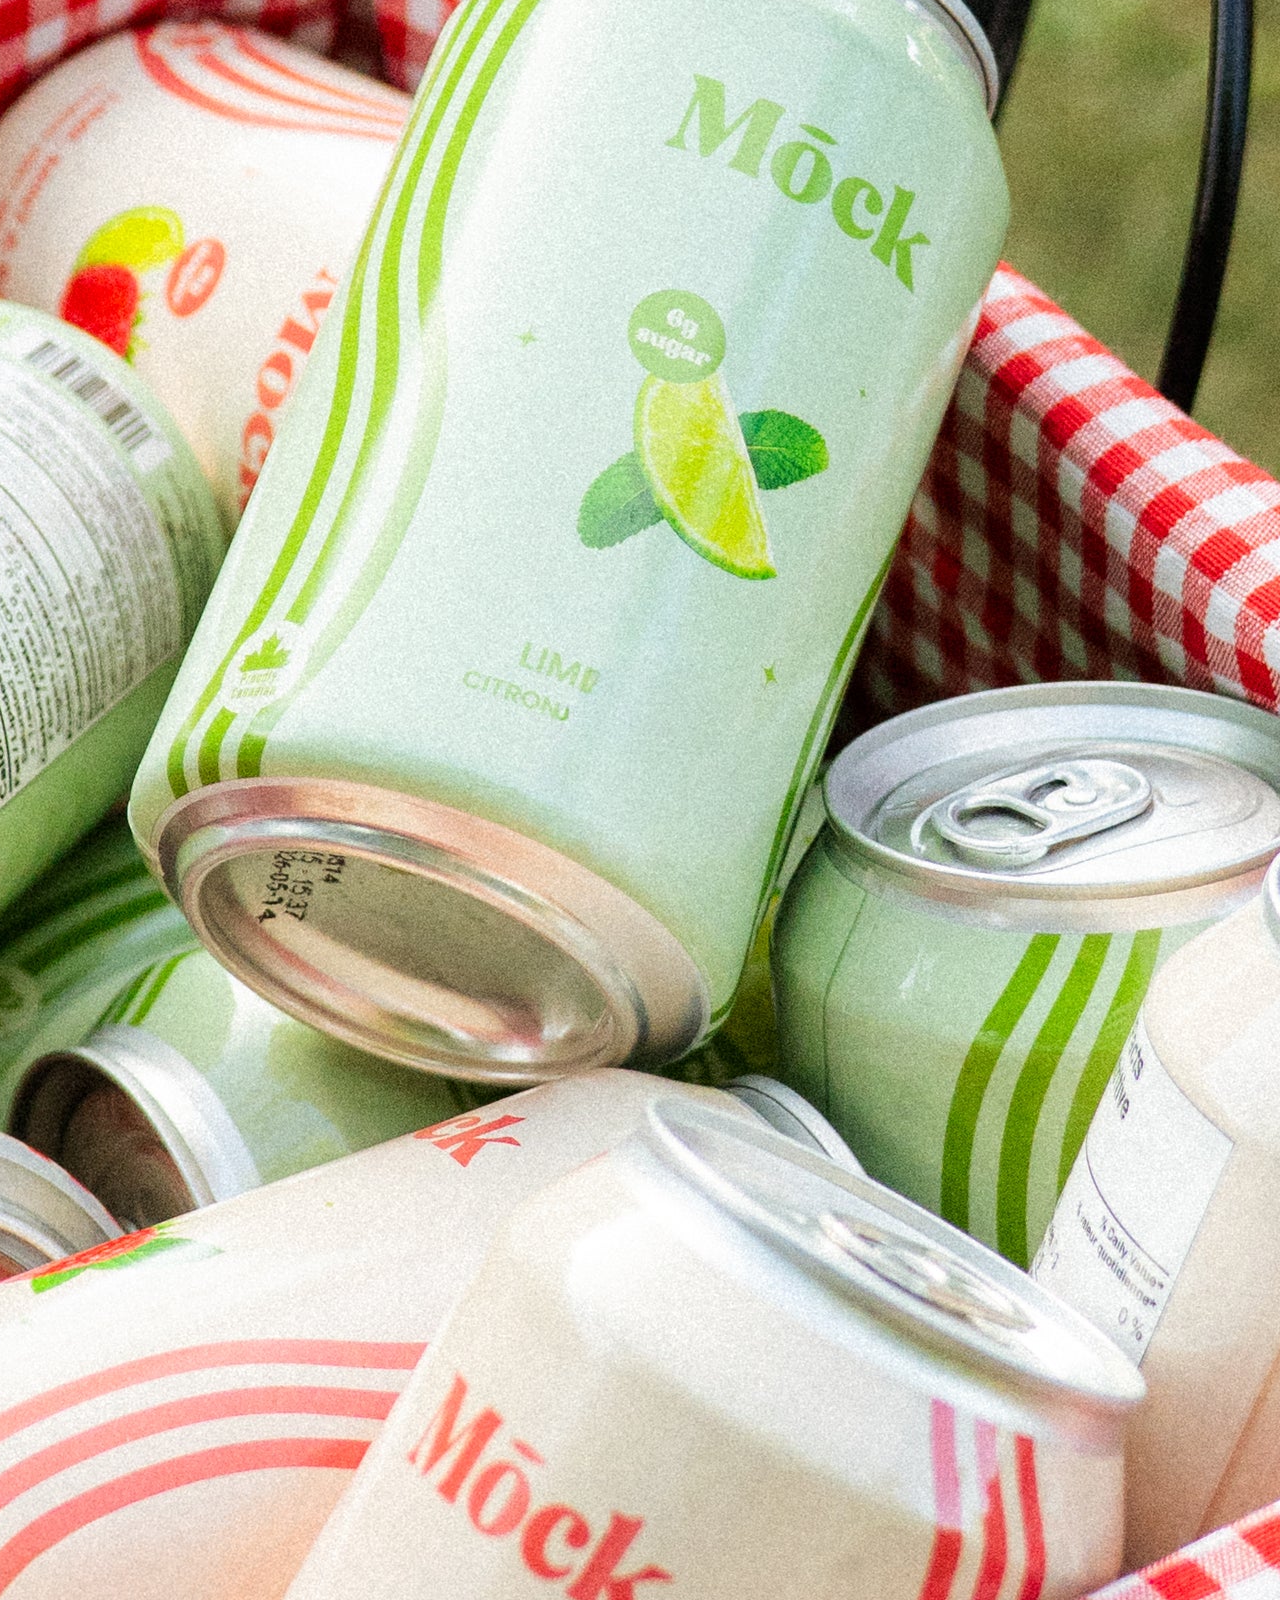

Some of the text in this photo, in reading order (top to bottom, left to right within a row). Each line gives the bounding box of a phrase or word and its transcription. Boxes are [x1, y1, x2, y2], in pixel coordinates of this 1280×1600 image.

[664, 73, 931, 294] Mōck
[666, 308, 698, 339] 6g
[635, 327, 712, 366] sugar
[413, 1114, 526, 1168] ck
[1117, 1307, 1145, 1342] 0 %
